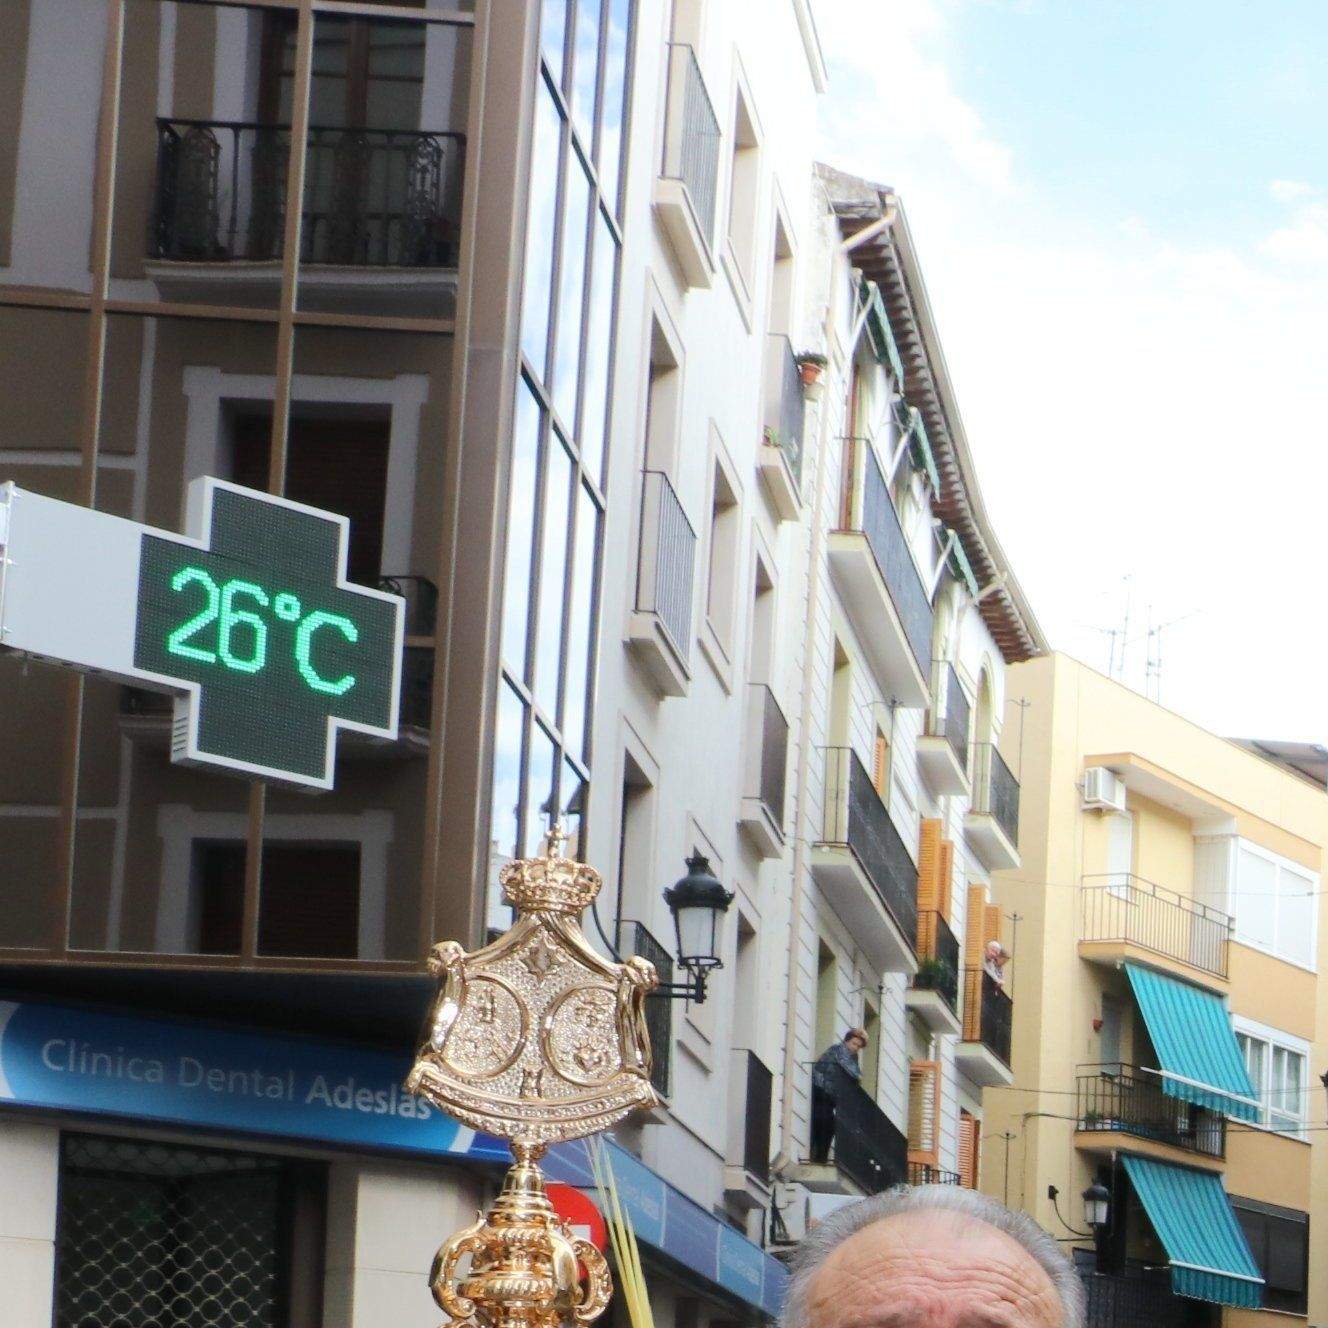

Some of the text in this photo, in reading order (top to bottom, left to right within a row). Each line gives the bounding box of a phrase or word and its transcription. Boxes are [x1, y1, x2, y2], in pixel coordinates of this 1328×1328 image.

[40, 1038, 433, 1120] Clínica Dental Adeslas
